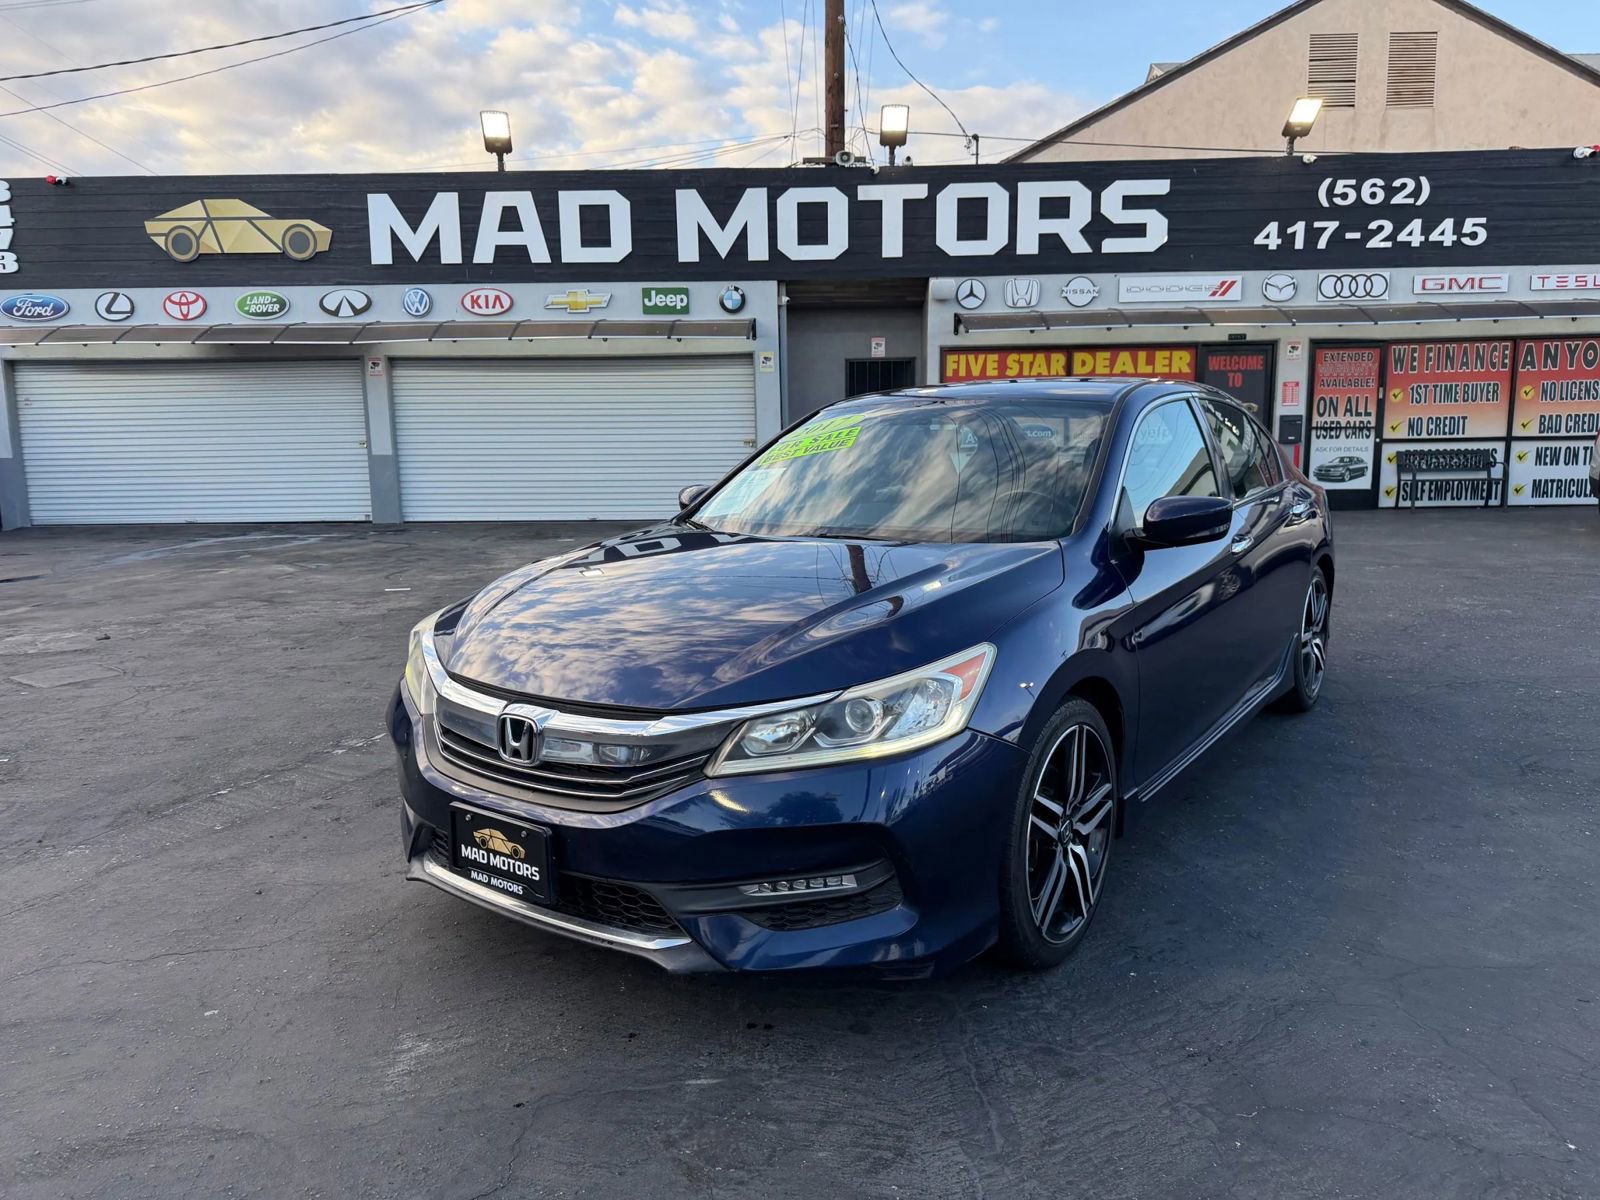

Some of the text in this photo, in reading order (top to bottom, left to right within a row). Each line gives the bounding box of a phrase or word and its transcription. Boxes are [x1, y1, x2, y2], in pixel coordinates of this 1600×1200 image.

[1317, 176, 1431, 207] (562)
[367, 179, 1171, 265] MAD MOTORS
[1253, 217, 1488, 250] 417-2445
[1126, 284, 1222, 293] DODGE
[1421, 276, 1503, 291] GMC
[1537, 275, 1600, 288] TESL
[12, 297, 55, 316] Ford
[246, 295, 272, 304] LAND
[249, 303, 280, 313] ROVER
[470, 294, 505, 309] KIA
[643, 289, 688, 310] Jeep
[946, 350, 1193, 377] FIVE STAR DEALER
[1208, 355, 1264, 371] WELCOME
[1323, 351, 1374, 362] EXTENDED
[1391, 342, 1511, 374] WE FINANCE
[1518, 340, 1600, 372] ANYO
[1228, 373, 1243, 388] TO
[1319, 377, 1375, 388] AVAILABLE!
[1540, 380, 1557, 402] NO
[1409, 382, 1500, 405] 1ST TIME BUYER
[1316, 395, 1372, 417] ON ALL
[1315, 420, 1372, 439] USED CARS
[1407, 415, 1468, 437] NO CREDIT
[1538, 413, 1563, 435] BAD
[802, 440, 848, 454] VALUE
[809, 429, 856, 444] SALE
[1534, 446, 1562, 467] NEW
[1563, 445, 1580, 466] ON
[461, 844, 540, 881] MAD MOTORS
[470, 871, 524, 895] MAD MOTORS
